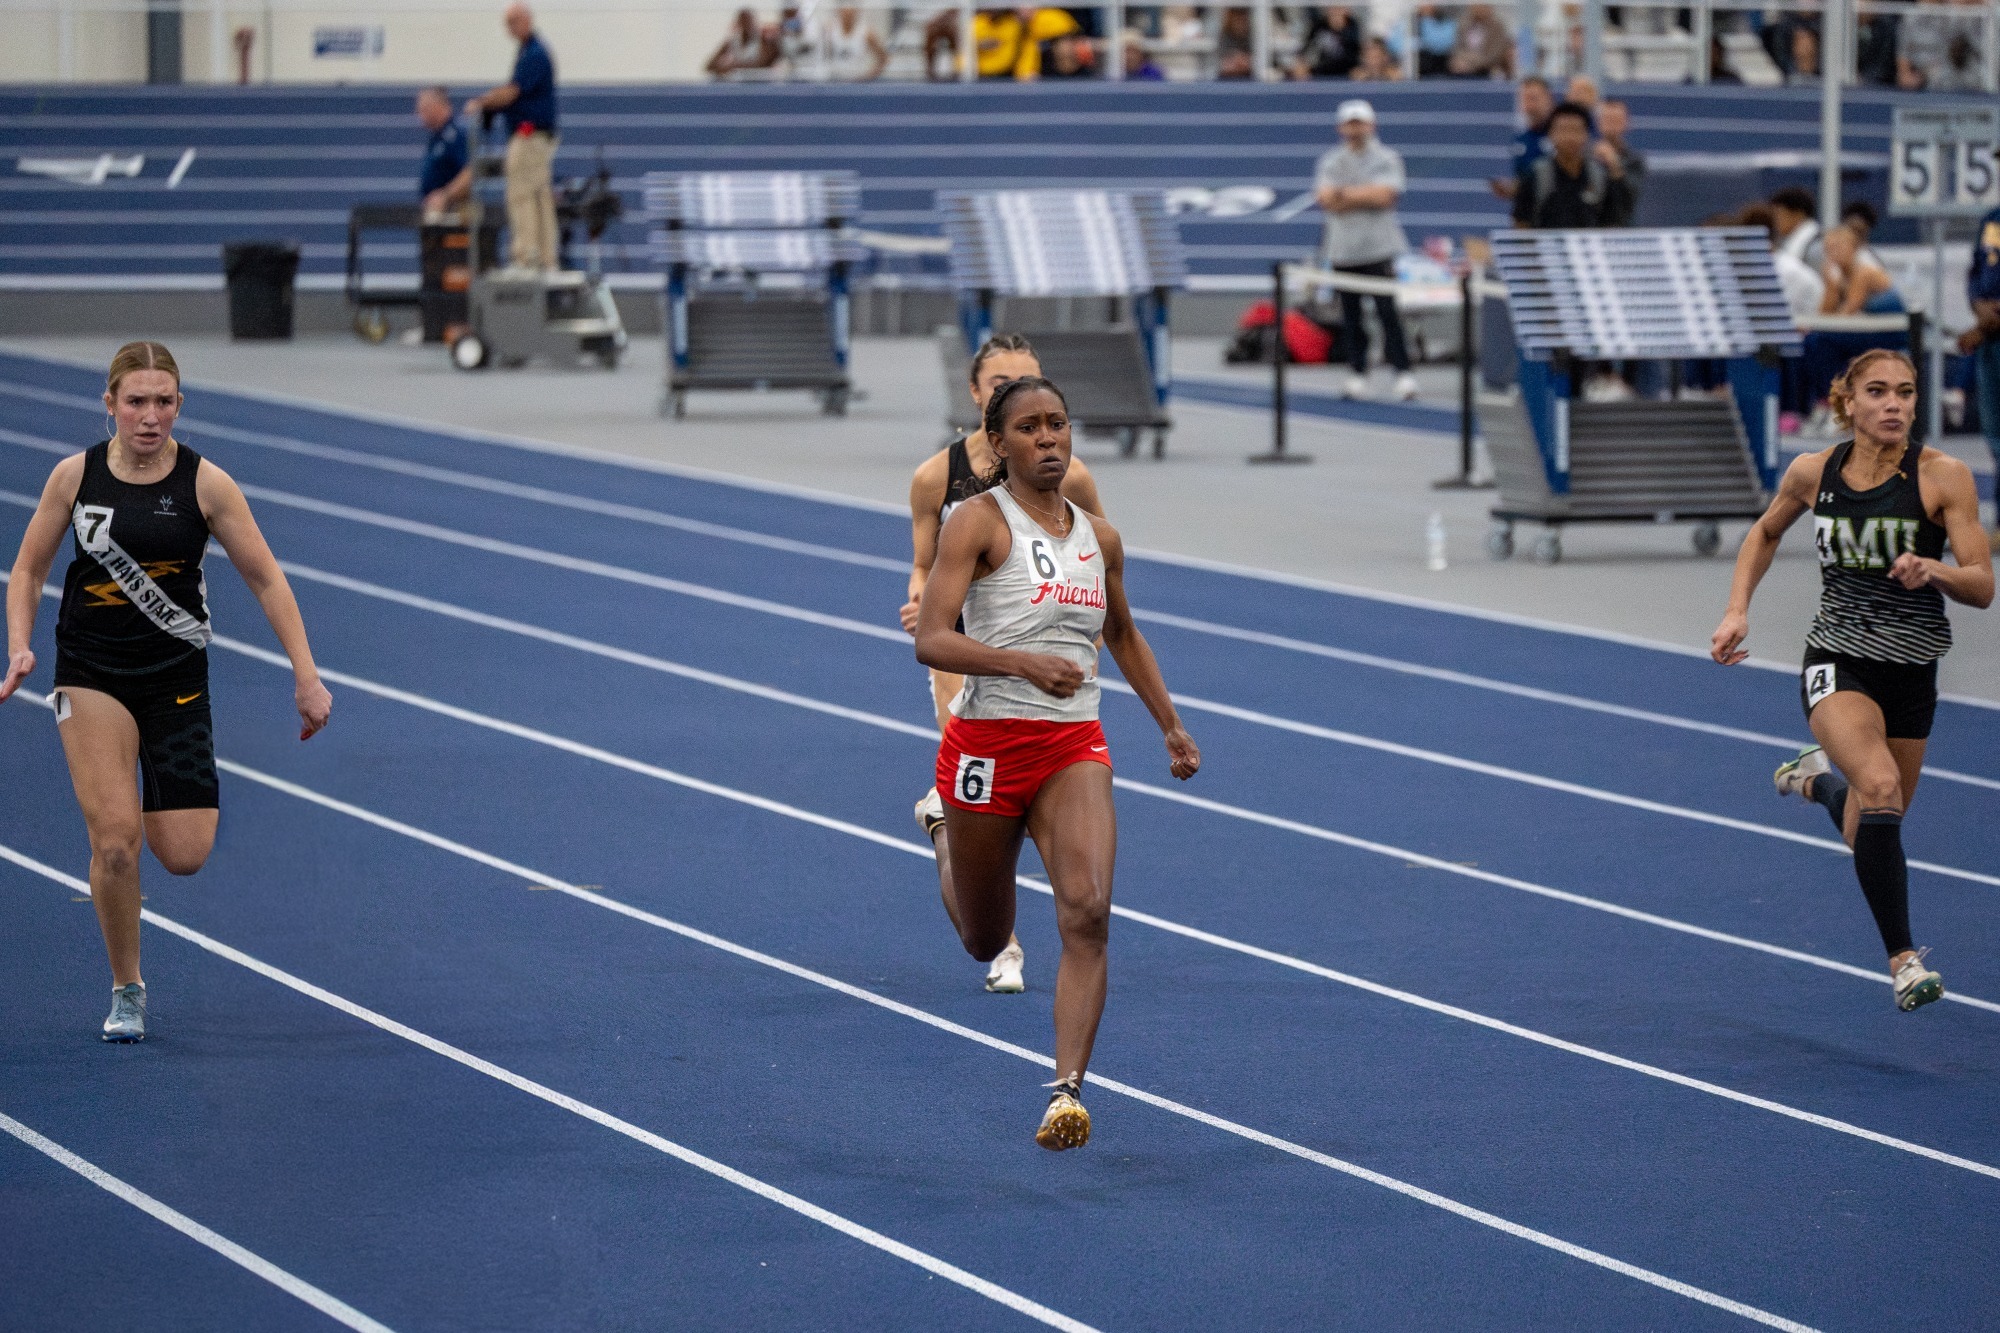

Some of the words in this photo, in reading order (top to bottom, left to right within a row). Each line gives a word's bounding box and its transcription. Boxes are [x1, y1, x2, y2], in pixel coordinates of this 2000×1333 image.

[1902, 140, 1930, 197] 5
[1965, 140, 1993, 197] 5
[84, 512, 107, 544] 7
[1031, 539, 1056, 580] 6
[109, 556, 145, 592] HAYS
[139, 589, 180, 627] STATE
[1810, 668, 1831, 696] 4
[962, 760, 985, 802] 6
